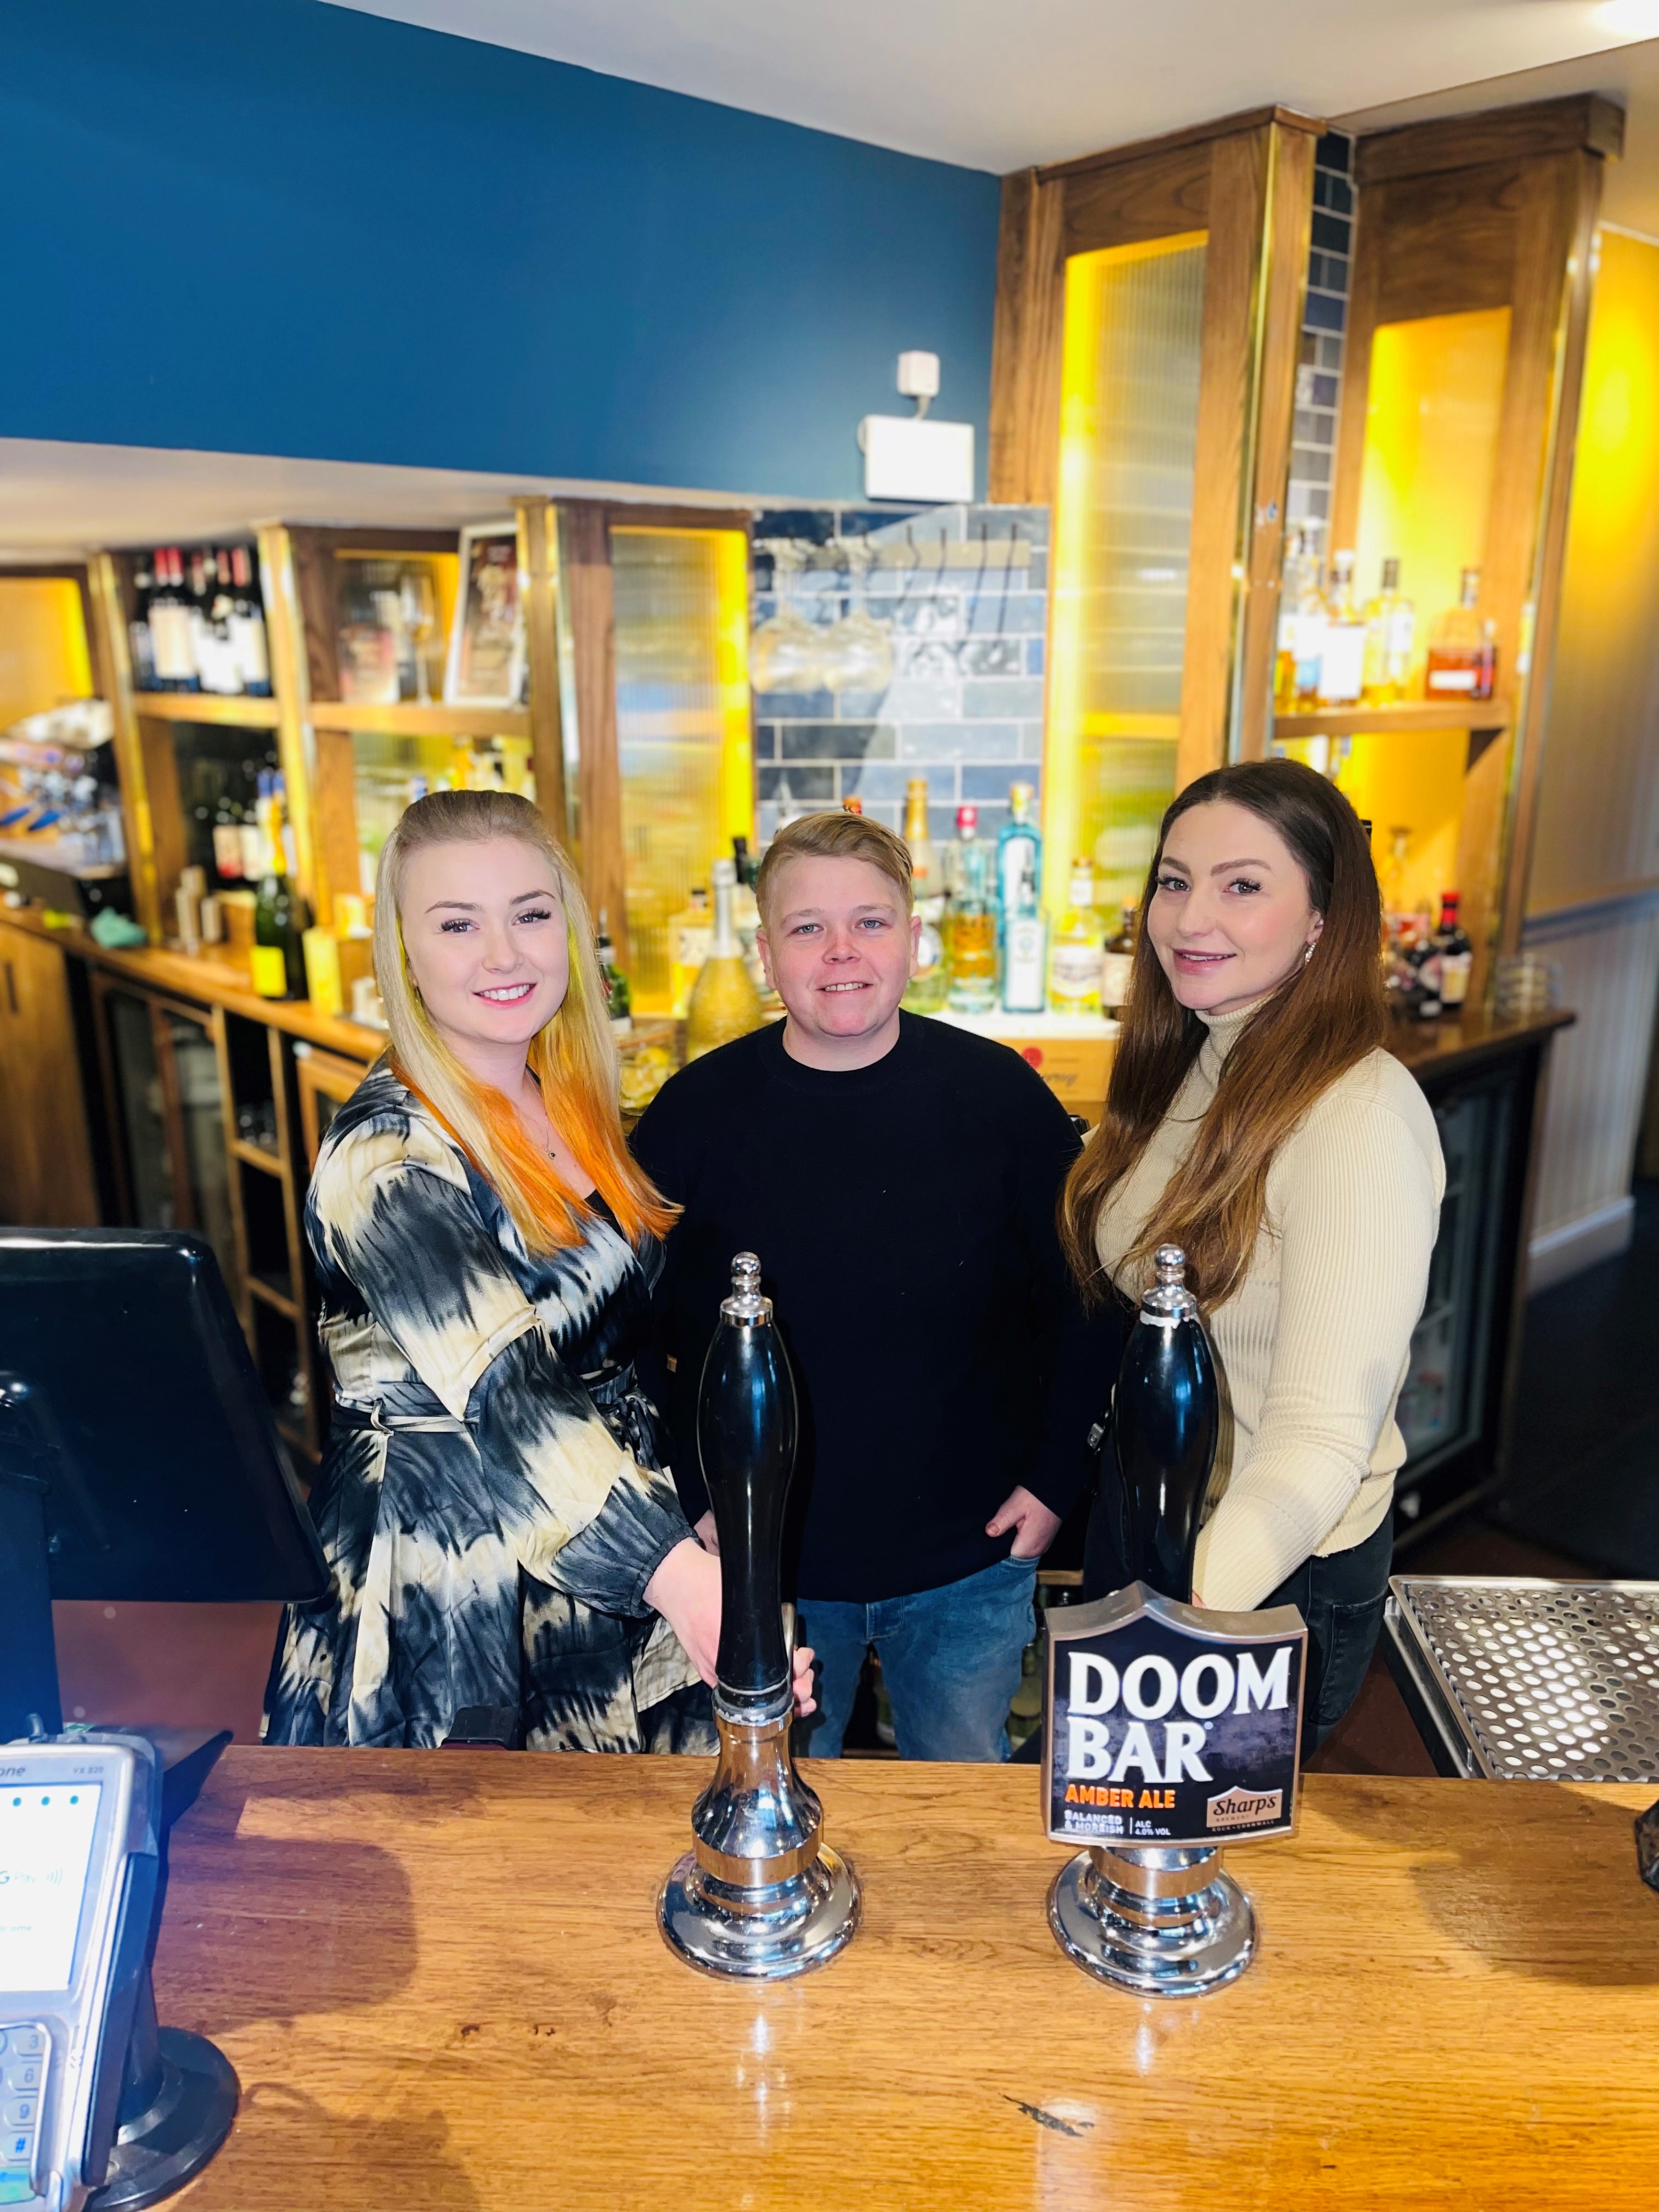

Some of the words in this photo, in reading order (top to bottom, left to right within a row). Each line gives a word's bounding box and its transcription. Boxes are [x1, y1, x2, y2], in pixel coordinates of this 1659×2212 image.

[1067, 1646, 1293, 1720] DOOM
[1066, 1716, 1214, 1784] BAR
[1065, 1784, 1135, 1808] AMBER
[1138, 1789, 1176, 1809] ALE
[1213, 1795, 1277, 1815] Sharp's
[1155, 1827, 1171, 1836] VOL
[29, 2034, 38, 2049] 3
[24, 2068, 34, 2083] 6
[19, 2103, 30, 2119] 9
